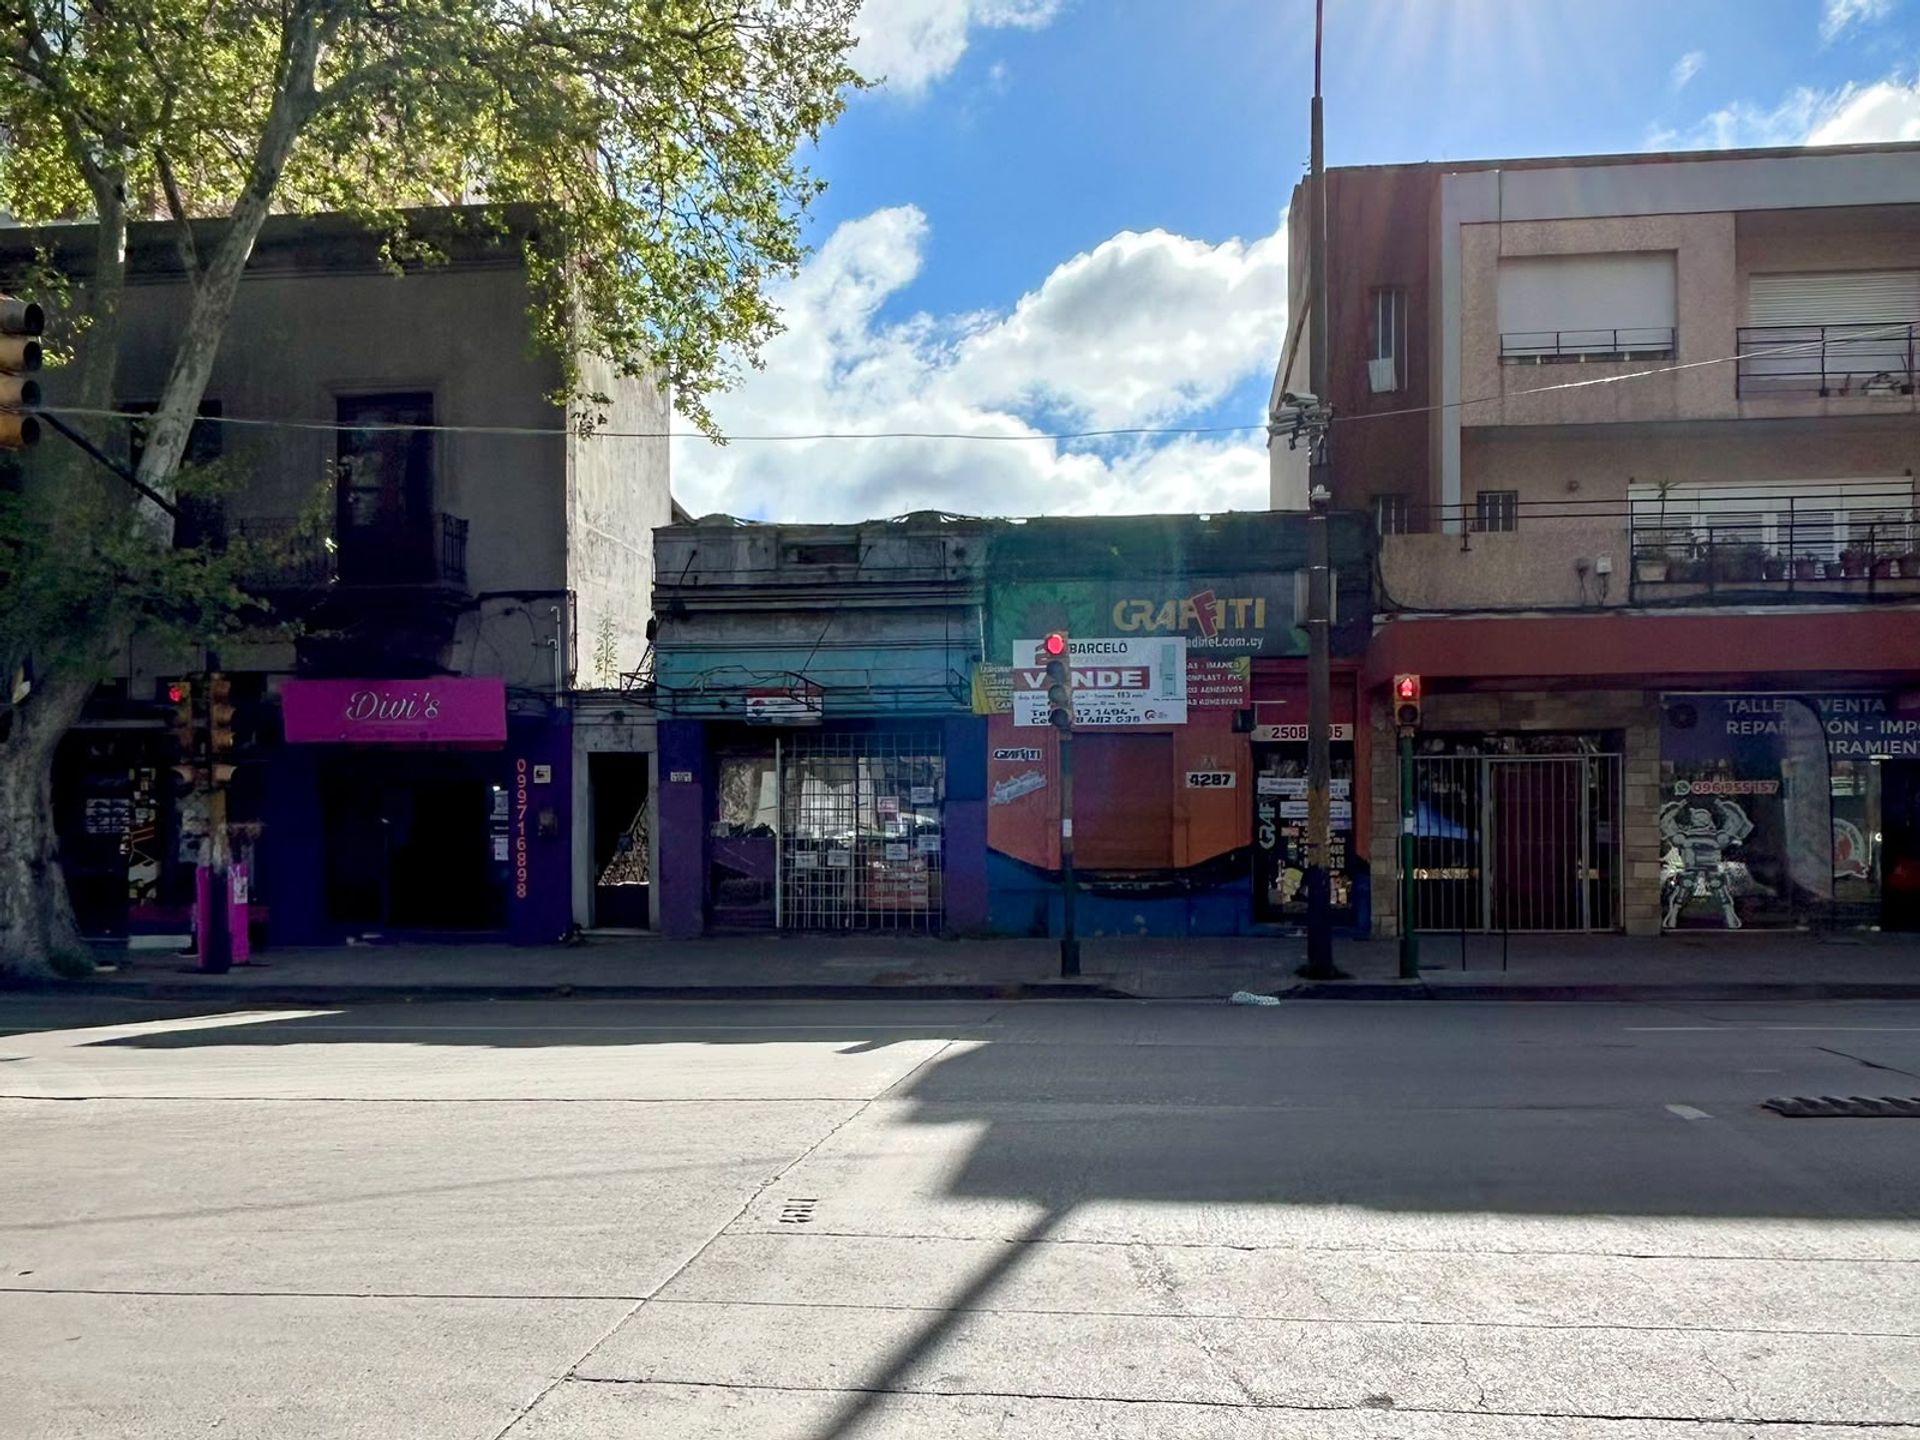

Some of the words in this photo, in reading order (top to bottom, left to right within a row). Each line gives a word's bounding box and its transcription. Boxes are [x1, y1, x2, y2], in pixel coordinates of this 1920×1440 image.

[1113, 589, 1265, 637] GRAFFITI
[1023, 670, 1143, 689] VNDE
[1728, 699, 1789, 714] TALLE
[1817, 698, 1887, 713] VENTA
[1726, 717, 1859, 735] REPARÓN
[1880, 719, 1920, 734] IMP
[1189, 774, 1231, 786] 4287
